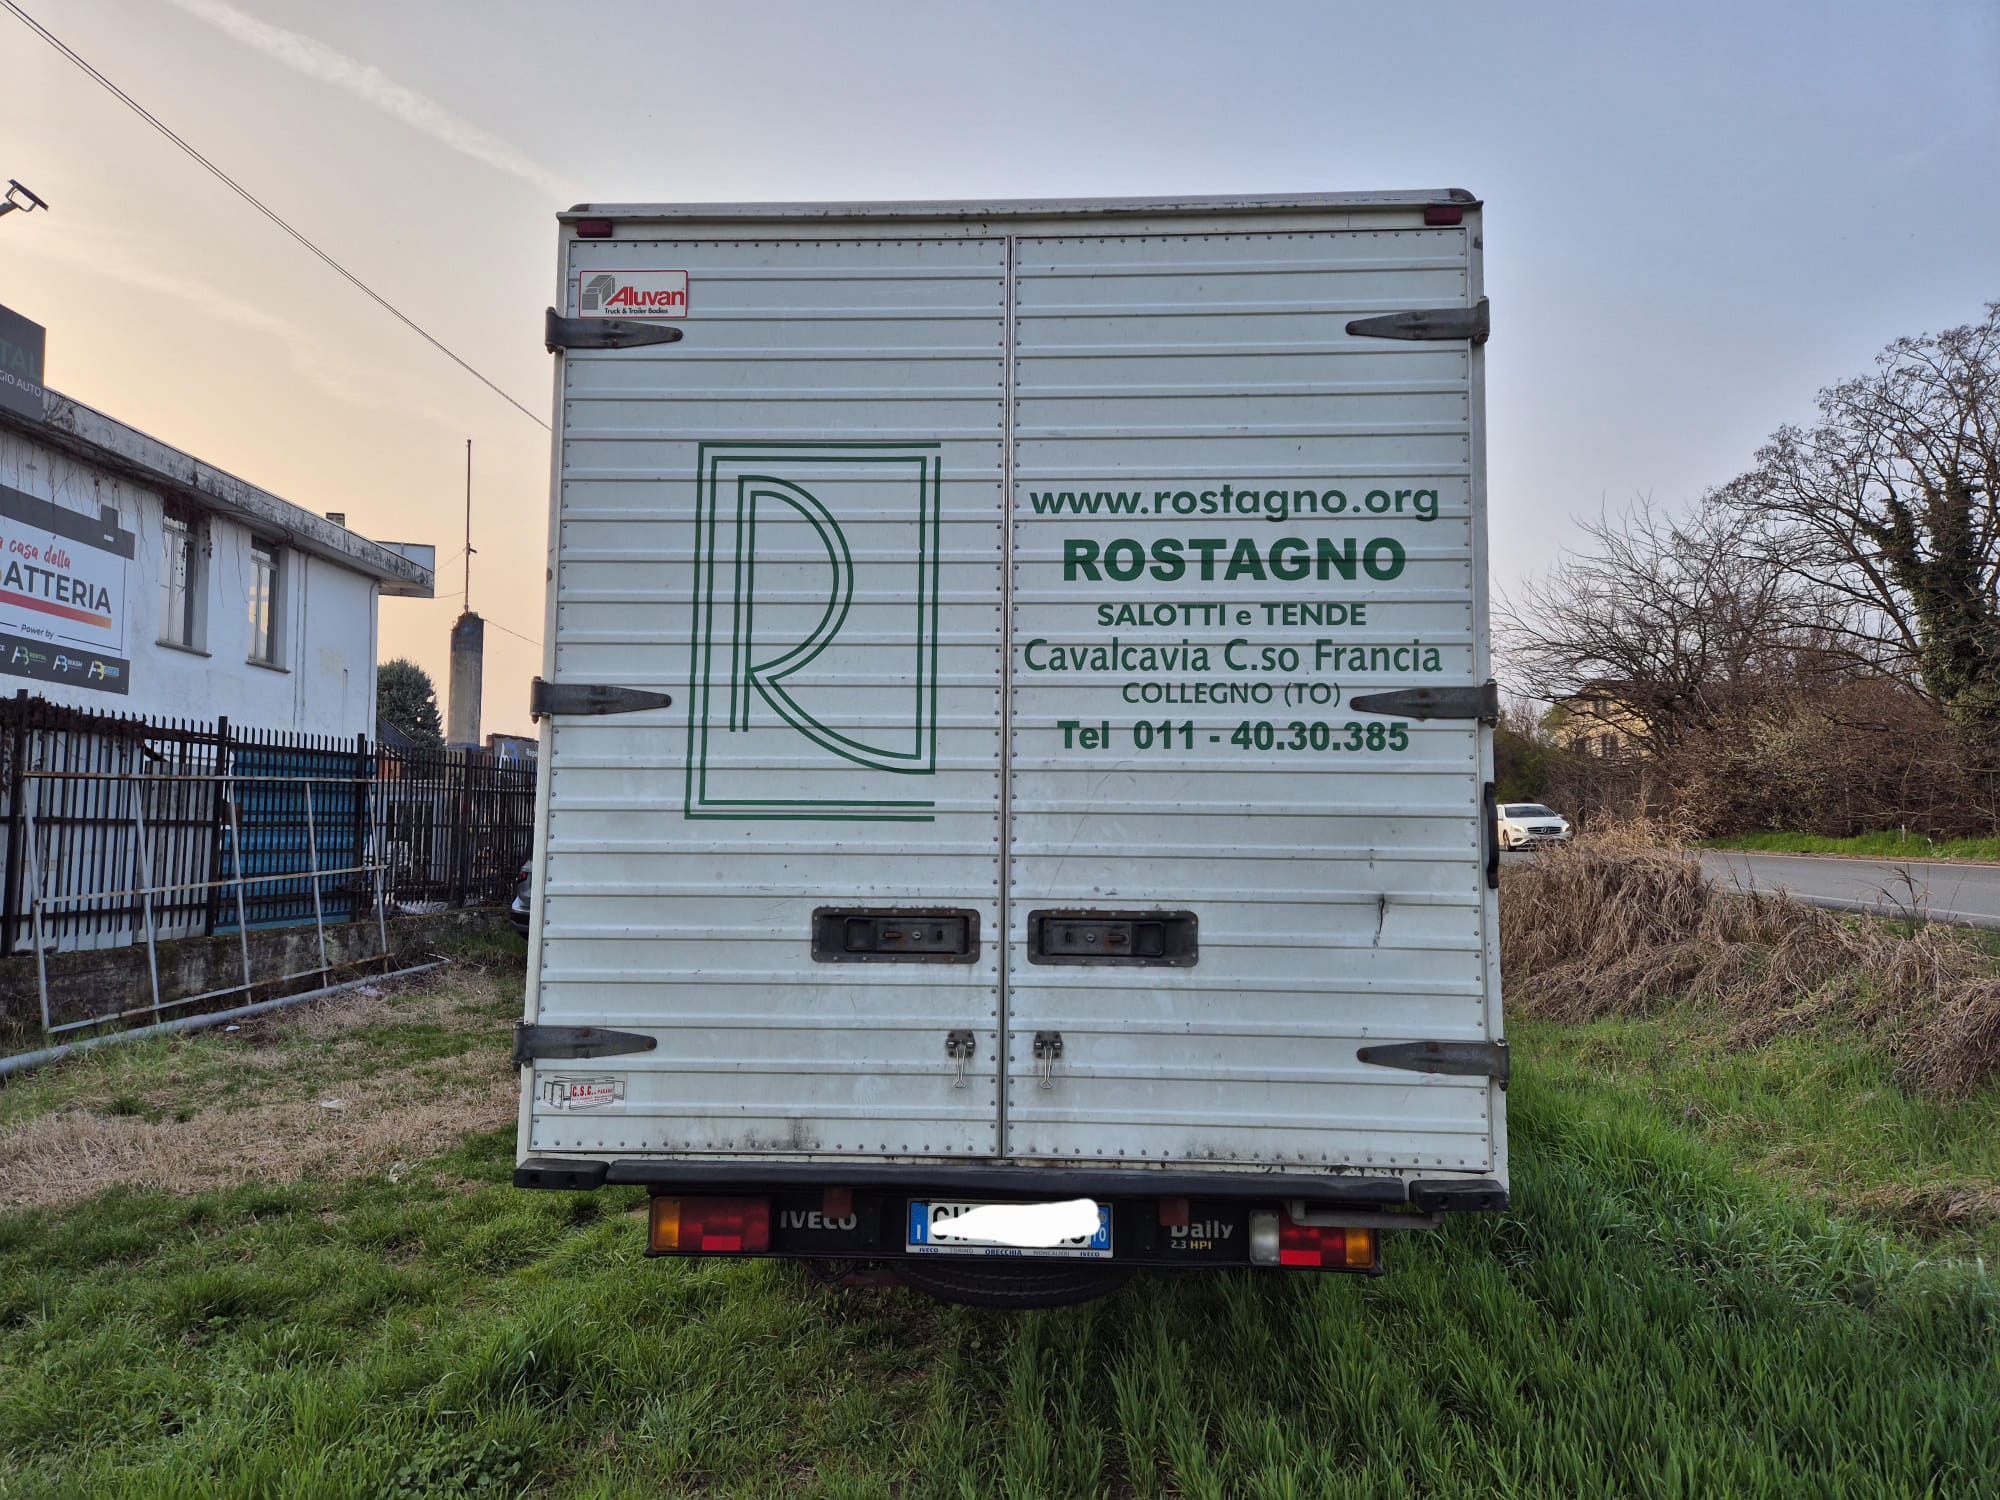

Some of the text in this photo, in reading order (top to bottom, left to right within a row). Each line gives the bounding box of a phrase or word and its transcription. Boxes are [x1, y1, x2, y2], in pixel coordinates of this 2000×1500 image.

[605, 286, 685, 306] Aluvan
[604, 307, 620, 315] Truck
[16, 378, 42, 398] AUTO
[1029, 484, 1439, 522] www.rostagno.org
[9, 539, 39, 560] casa
[43, 544, 71, 570] della
[1063, 537, 1407, 582] ROSTAGNO
[0, 560, 112, 615] ATTERIA
[1097, 603, 1367, 627] SALOTTI e TENDE
[20, 623, 55, 640] Power by
[1024, 636, 1443, 672] Cavalcavia C.so Francia
[1122, 682, 1341, 708] COLLEGNO (TO)
[1057, 720, 1410, 752] Tel 011 - 40.30.385
[780, 1210, 857, 1230] IVECO
[1171, 1220, 1234, 1239] Daily
[1190, 1240, 1212, 1250] HPI
